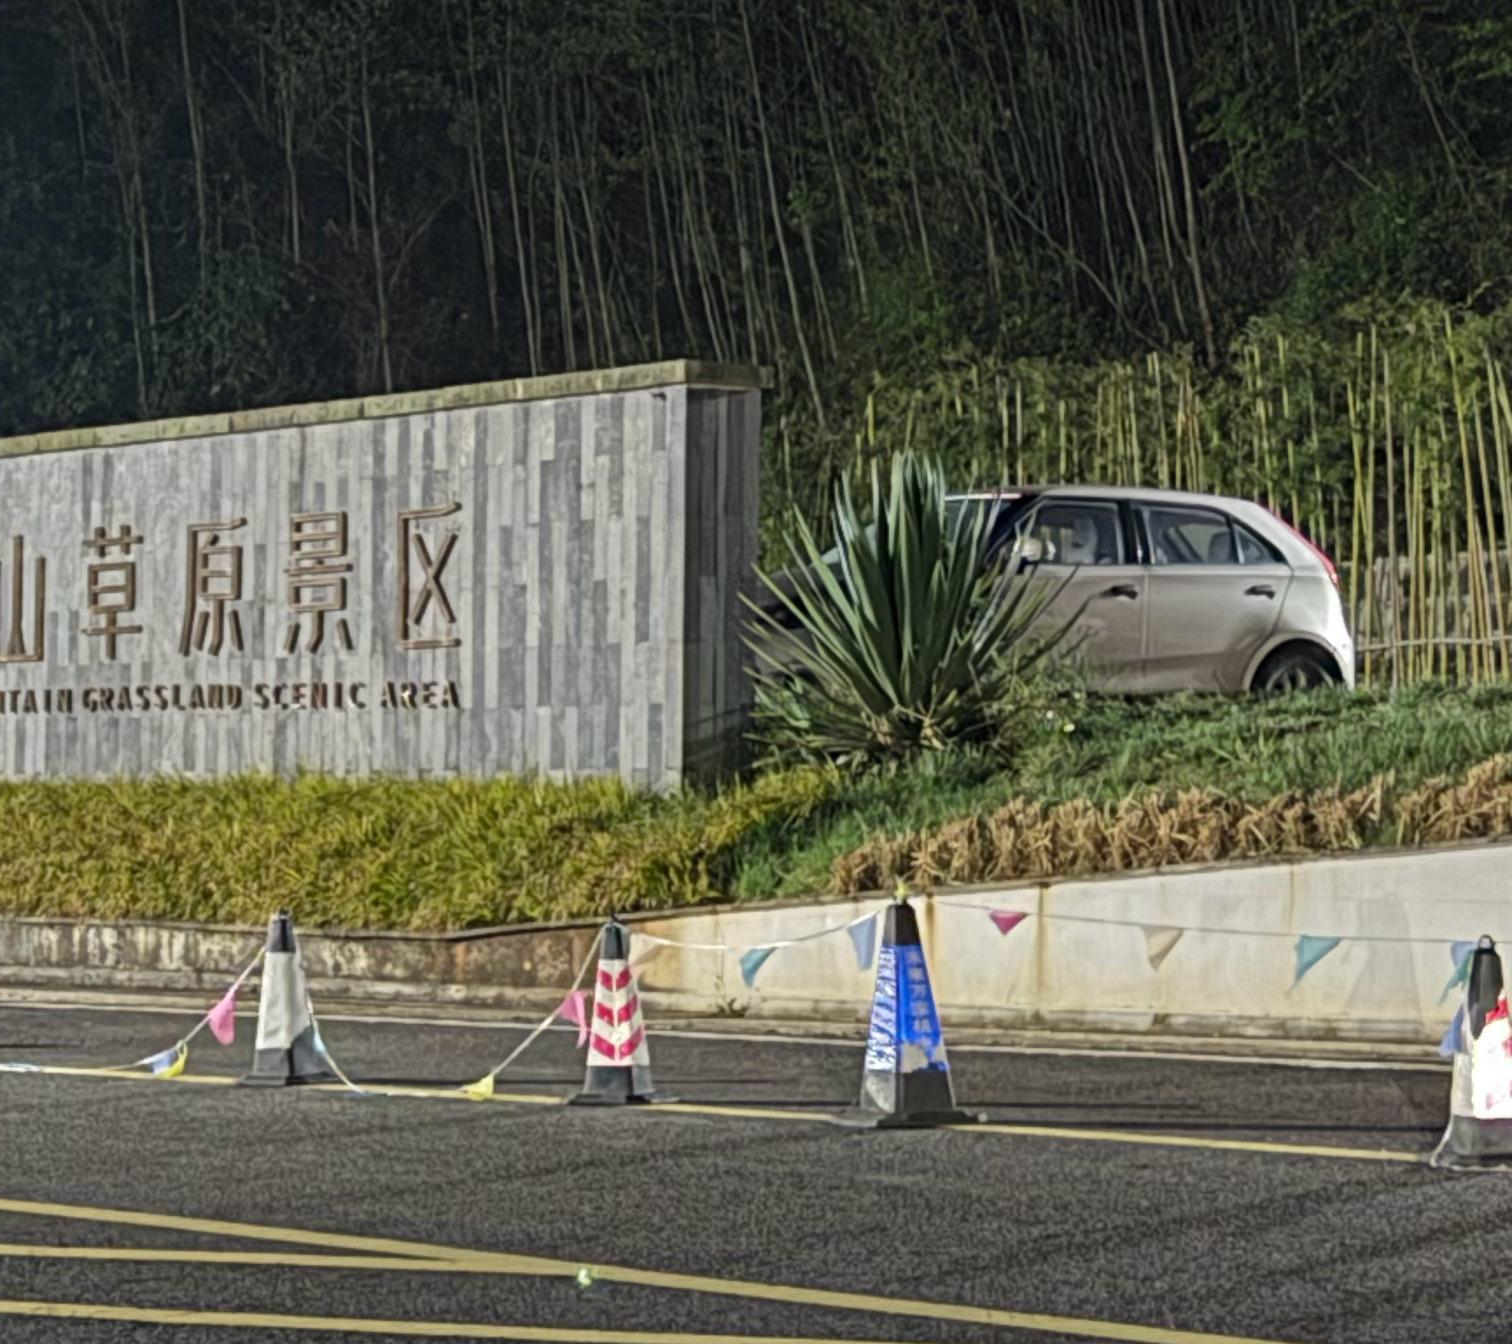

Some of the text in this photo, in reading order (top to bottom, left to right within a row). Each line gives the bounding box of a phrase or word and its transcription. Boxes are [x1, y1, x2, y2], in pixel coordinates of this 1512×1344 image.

[82, 683, 243, 712] GRASSLAND
[254, 682, 367, 710] SCENIC
[381, 680, 462, 710] AREA
